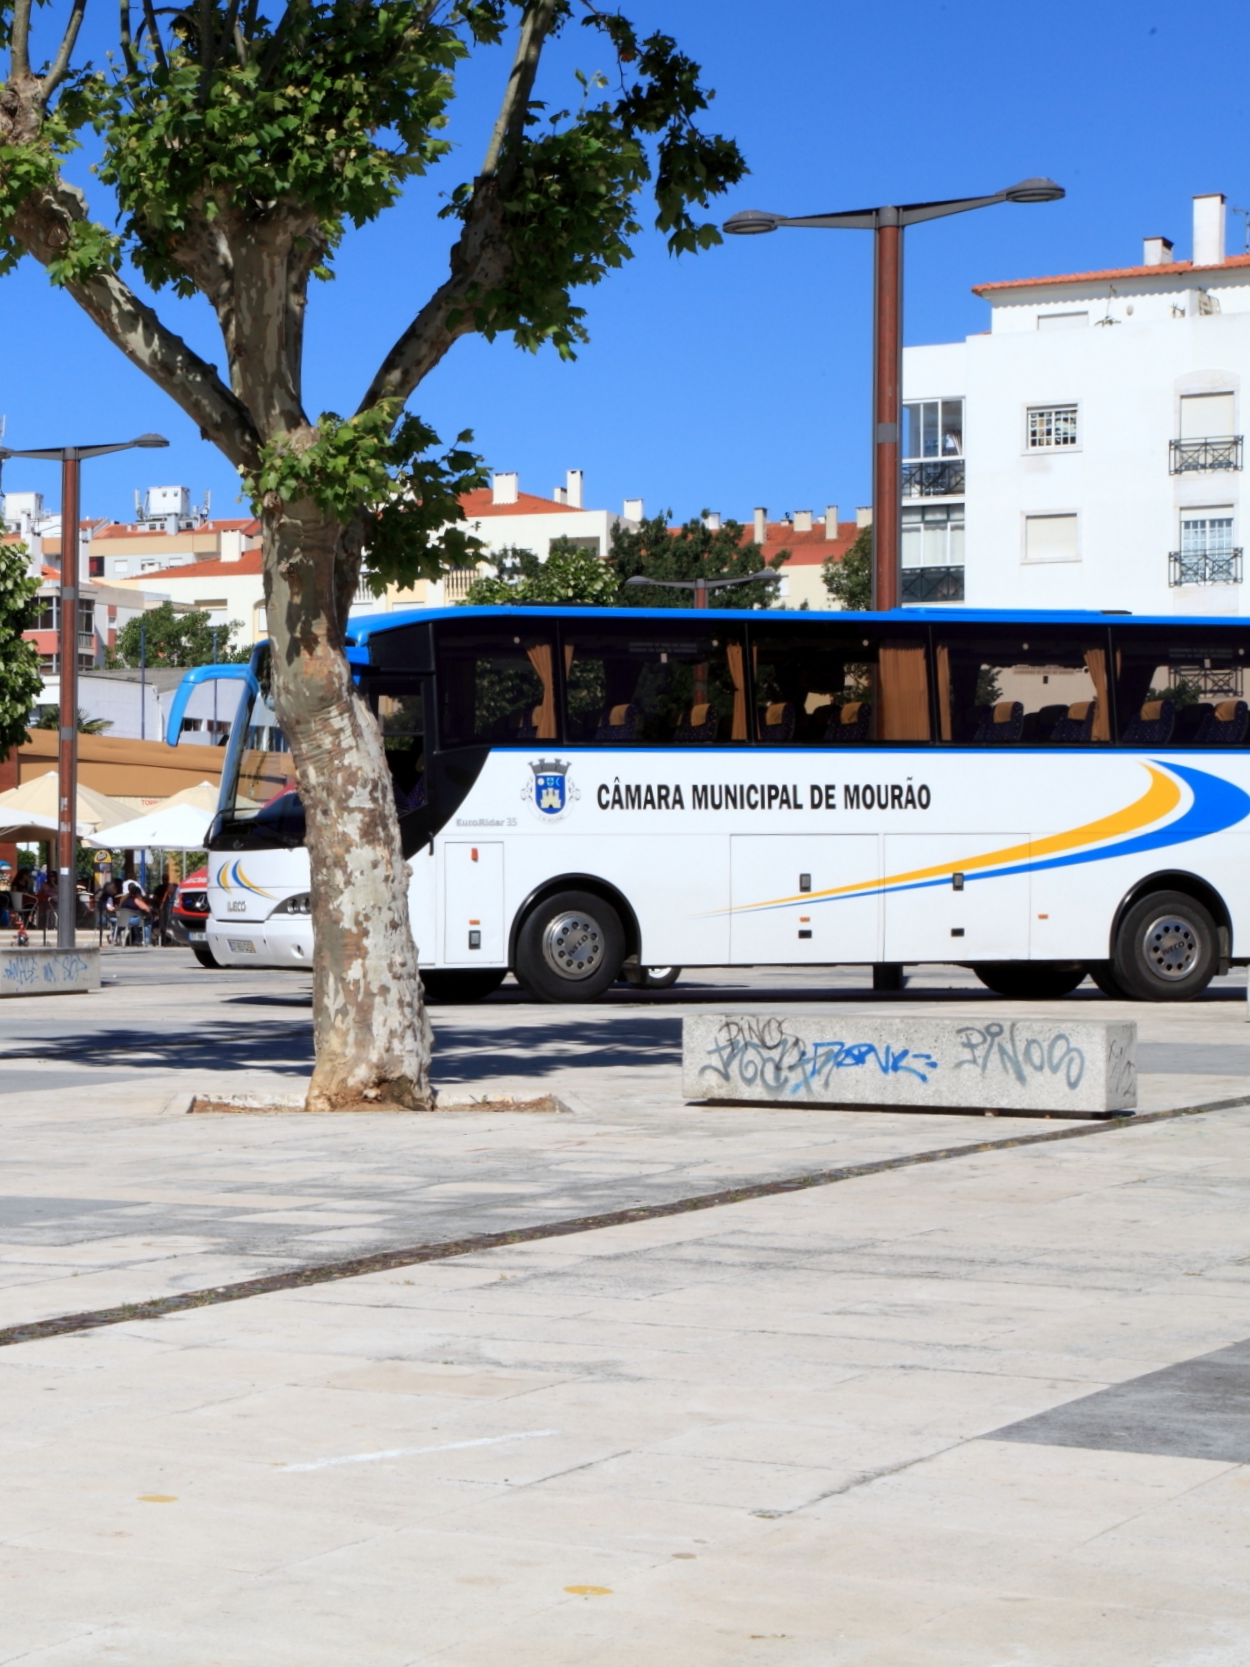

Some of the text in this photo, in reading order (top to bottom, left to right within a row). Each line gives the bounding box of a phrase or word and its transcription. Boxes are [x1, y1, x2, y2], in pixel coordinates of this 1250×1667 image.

[597, 776, 931, 810] CÂMARA MUNICIPAL DE MOURÃO
[506, 817, 517, 827] 35
